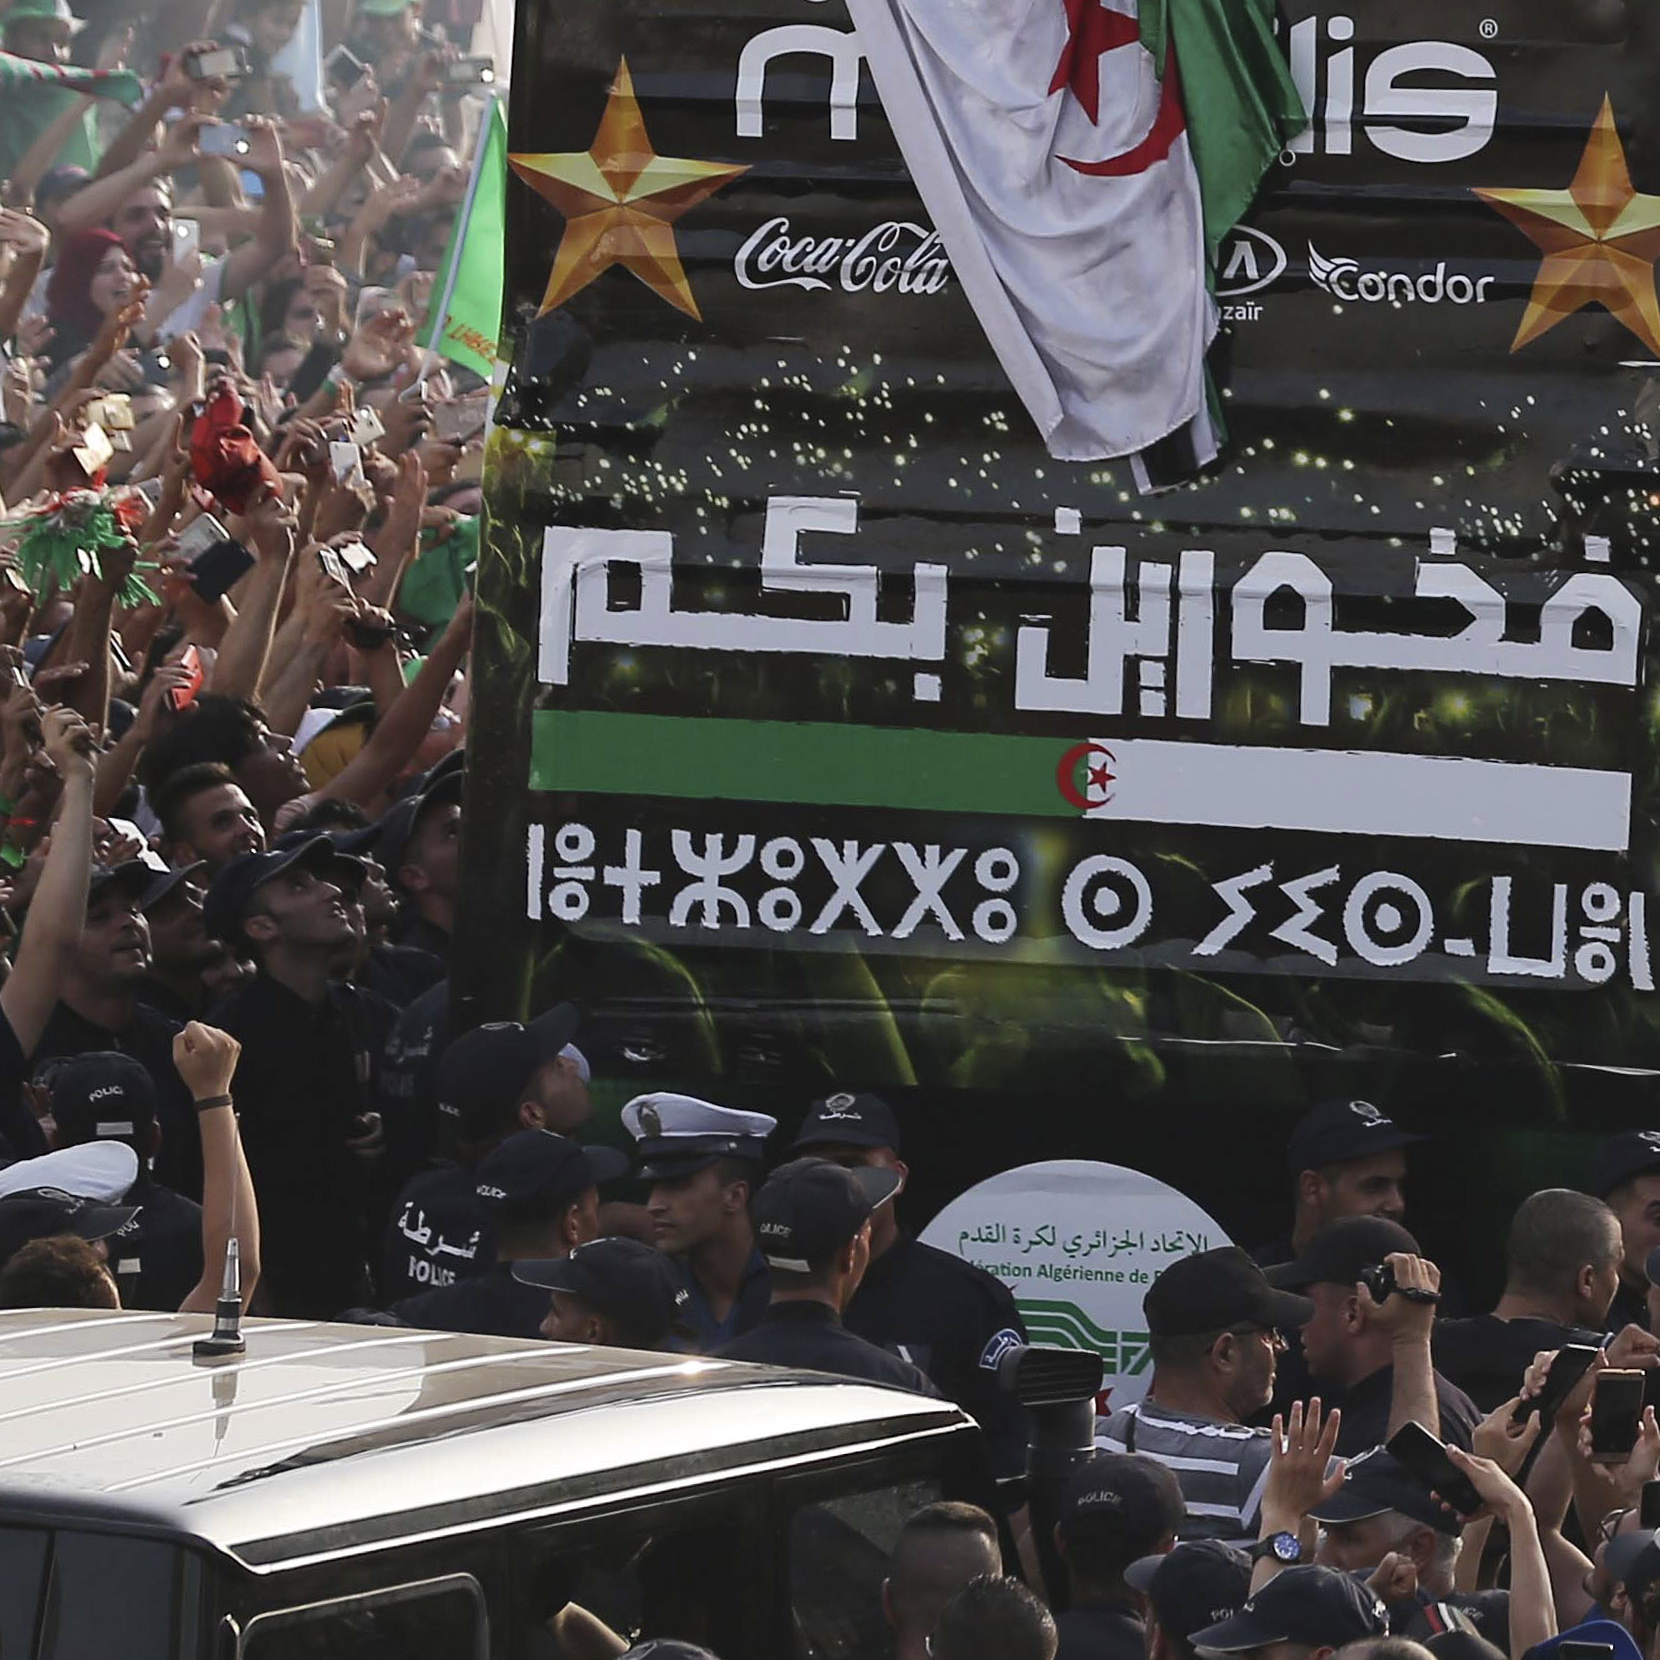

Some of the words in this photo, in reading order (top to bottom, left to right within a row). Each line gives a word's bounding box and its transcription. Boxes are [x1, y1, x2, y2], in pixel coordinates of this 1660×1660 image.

[735, 16, 1498, 163] mlis
[1322, 256, 1495, 304] Condor
[537, 495, 949, 703] بكم
[1013, 1224, 1056, 1253] لكرة
[1037, 1263, 1124, 1284] Algérienne
[1129, 1268, 1149, 1283] de
